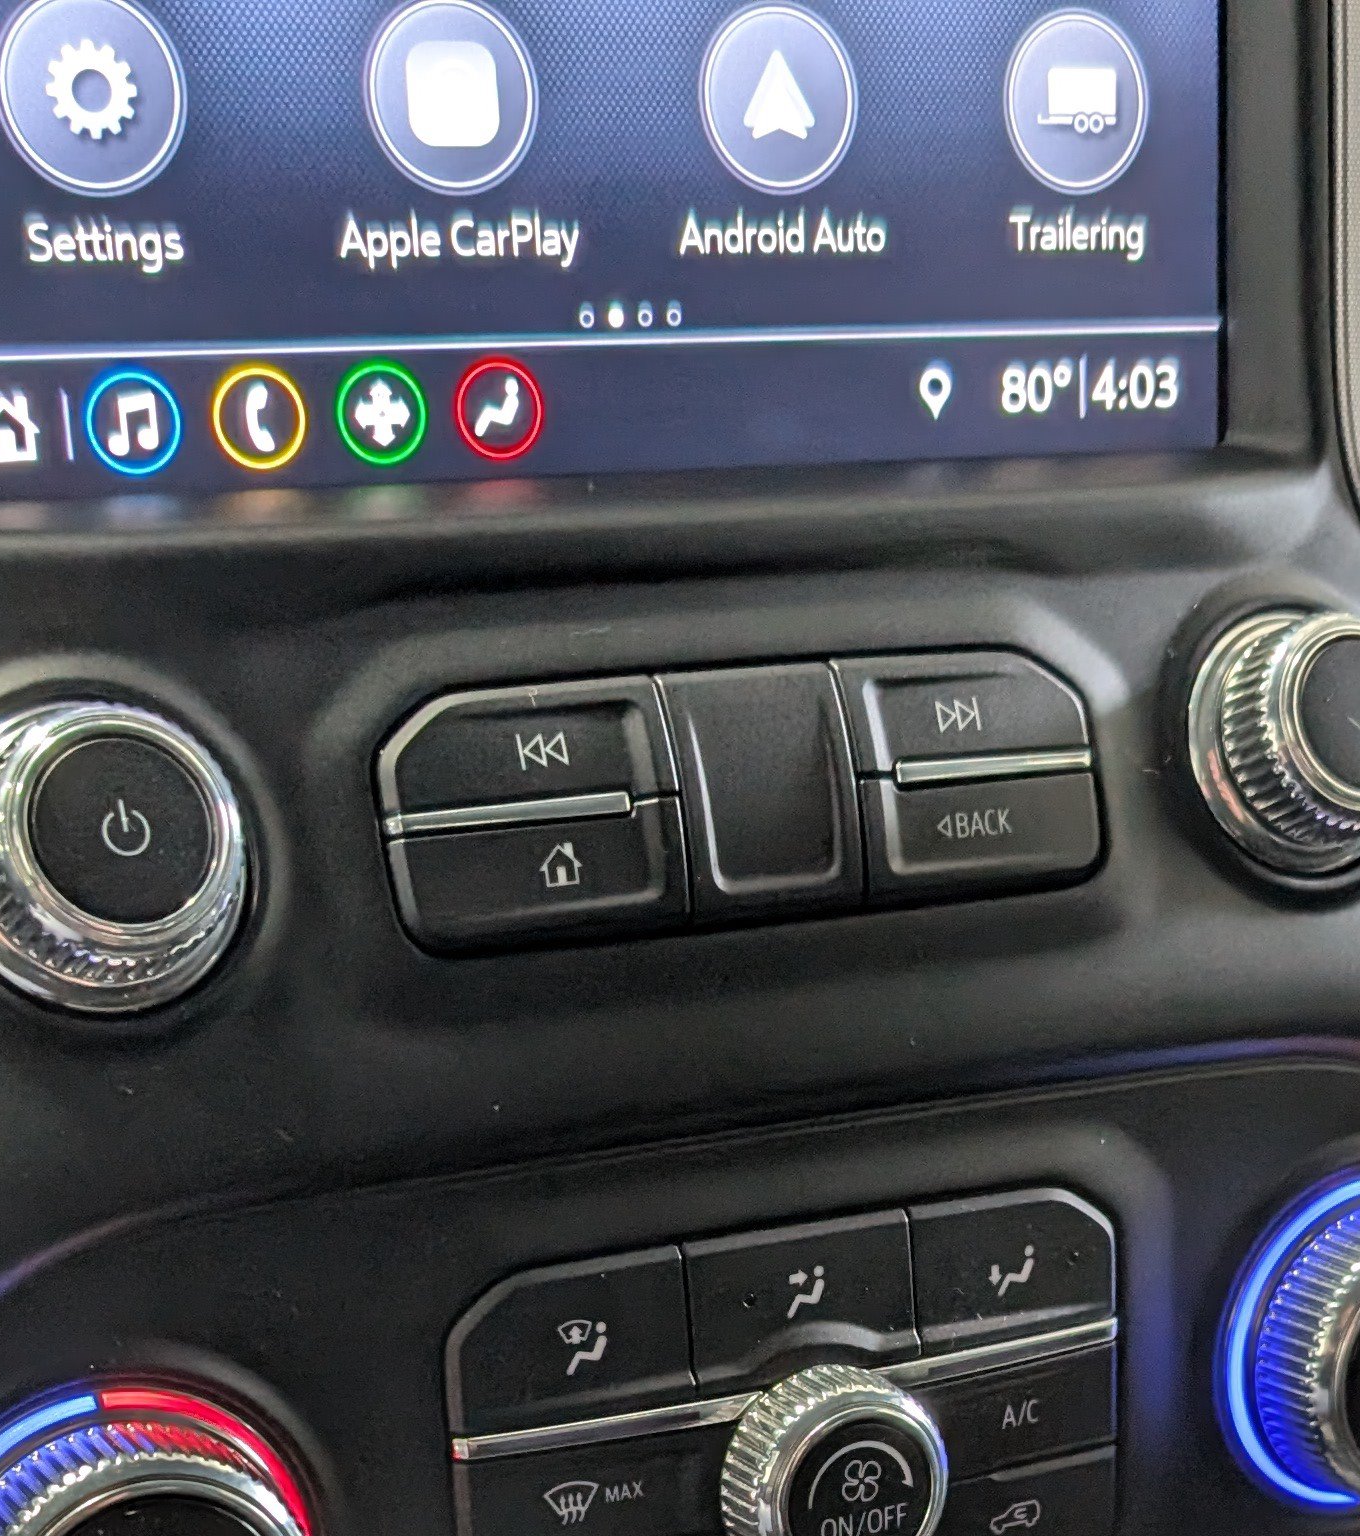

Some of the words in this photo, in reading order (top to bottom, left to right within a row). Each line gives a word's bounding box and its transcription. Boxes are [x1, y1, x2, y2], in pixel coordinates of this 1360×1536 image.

[26, 221, 185, 274] Settings
[339, 217, 441, 270] Apple
[450, 215, 580, 268] CarPlay
[679, 214, 805, 256] Android
[812, 215, 886, 254] Auto
[1008, 213, 1145, 261] Trailering
[1001, 364, 1072, 414] 80°
[1091, 364, 1180, 412] 4:03
[955, 807, 1013, 839] BACK
[1001, 1398, 1040, 1430] A/C
[604, 1480, 645, 1503] MAX
